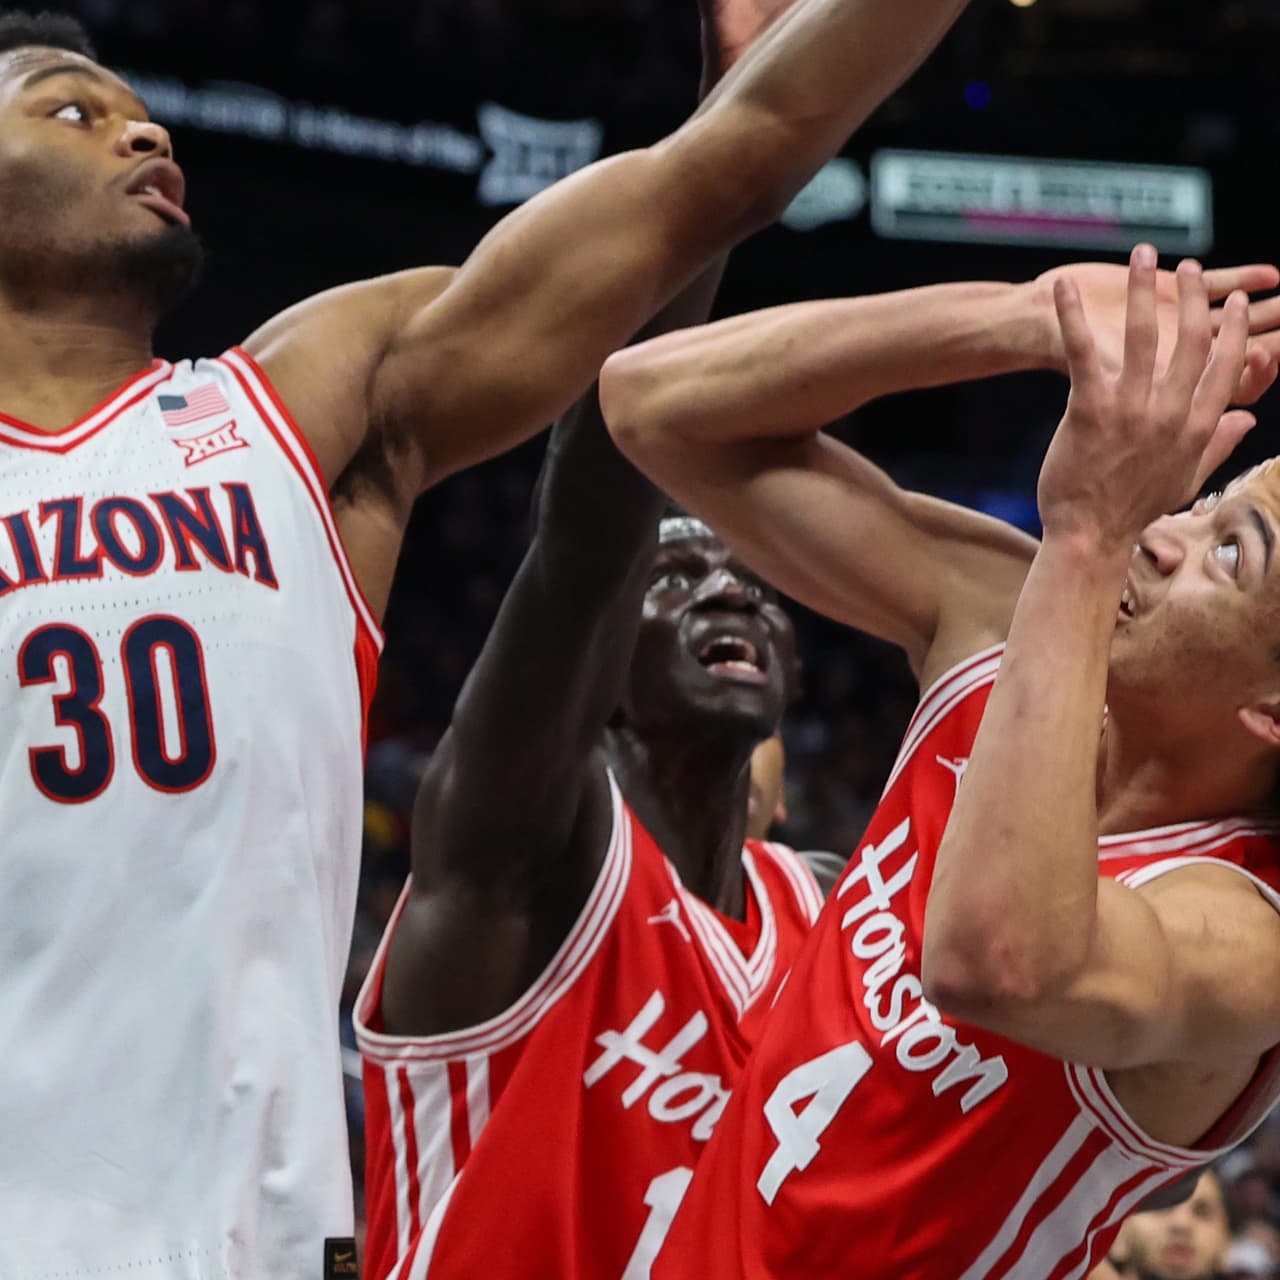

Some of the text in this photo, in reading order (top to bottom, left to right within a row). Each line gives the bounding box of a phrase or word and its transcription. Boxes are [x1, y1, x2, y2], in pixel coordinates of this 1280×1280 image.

[17, 614, 217, 805] 30
[836, 816, 1009, 1115] Houston
[756, 1039, 874, 1208] 4
[621, 1165, 695, 1280] 1
